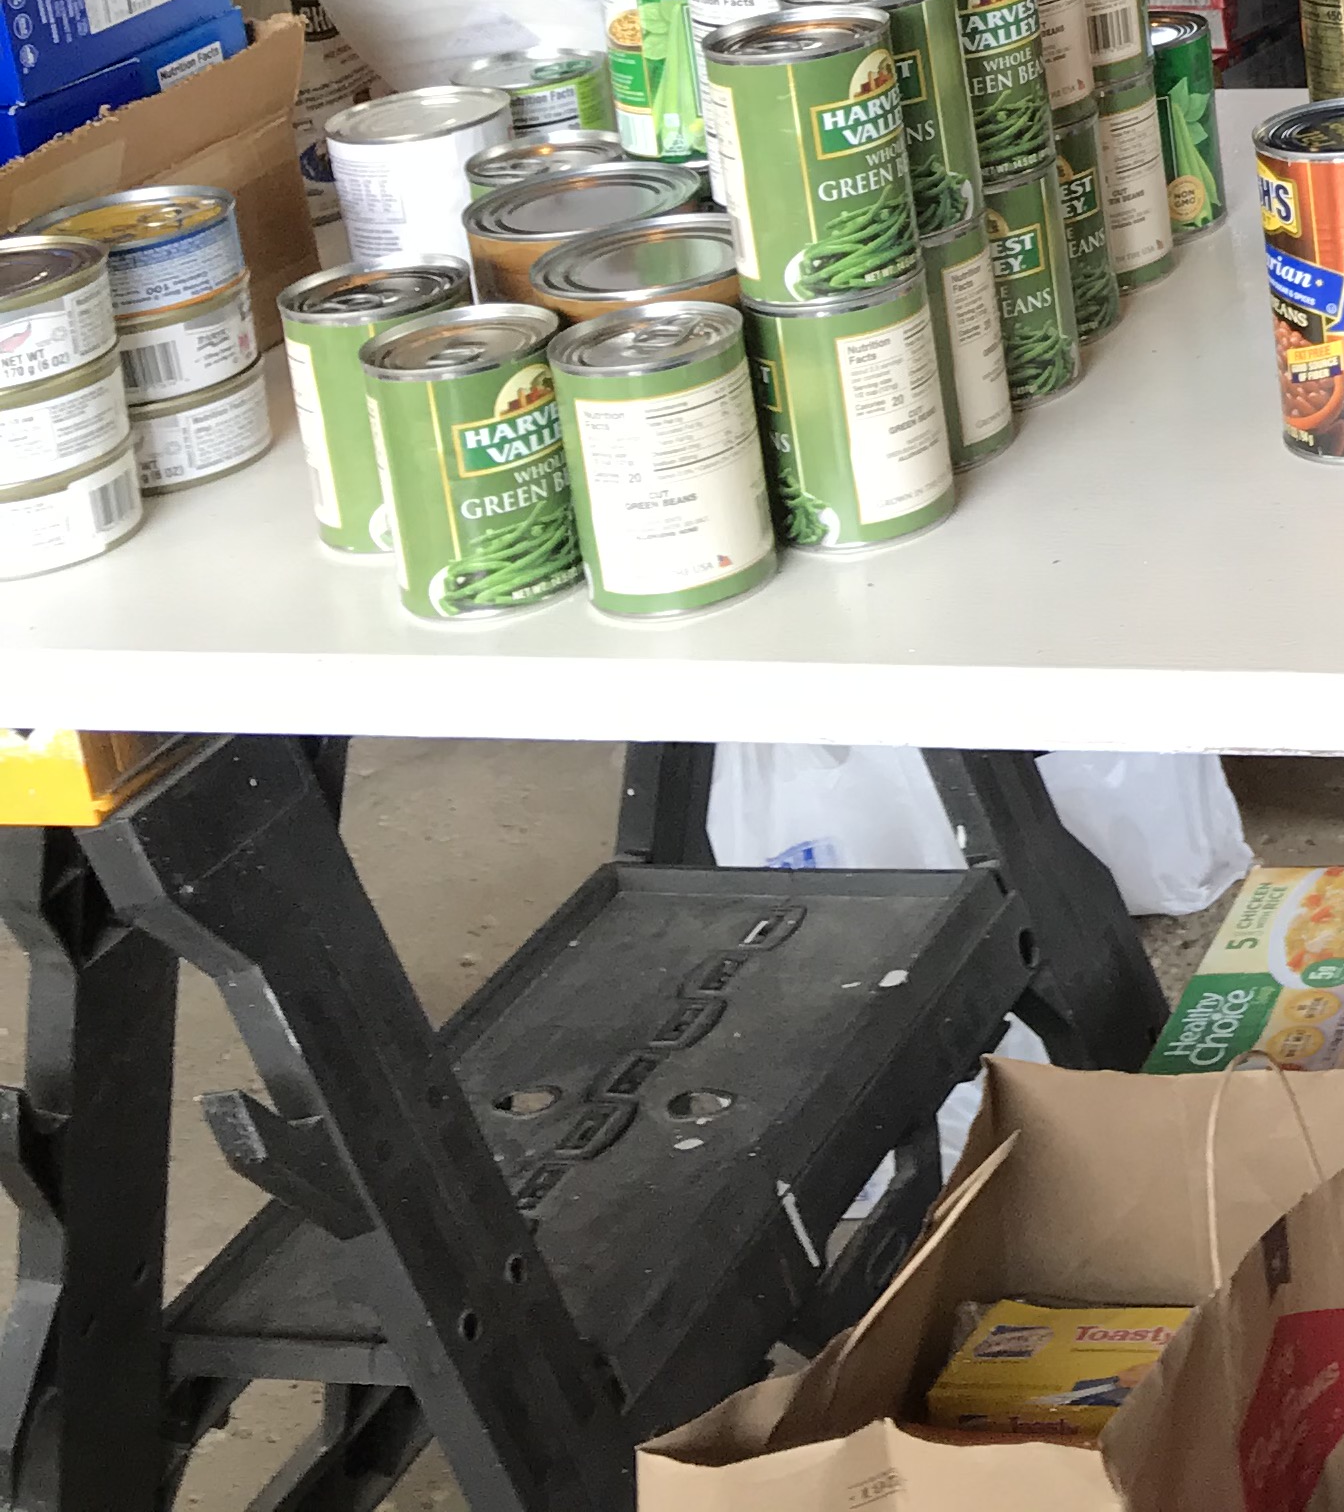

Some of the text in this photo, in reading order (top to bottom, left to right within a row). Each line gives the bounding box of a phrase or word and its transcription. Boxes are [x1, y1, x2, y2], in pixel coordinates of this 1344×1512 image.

[198, 47, 219, 63] Facts
[818, 163, 892, 202] GREEN
[1173, 190, 1195, 201] NON
[1175, 197, 1196, 207] GMO
[1, 349, 45, 366] NET WT
[464, 401, 558, 449] HARVE
[486, 426, 562, 463] VALLE
[461, 484, 547, 519] GREEN
[1236, 882, 1272, 929] CHICKEN
[1268, 886, 1288, 909] RICE
[1225, 937, 1258, 950] 5
[1164, 992, 1224, 1057] Healthy
[1189, 989, 1254, 1065] Choice
